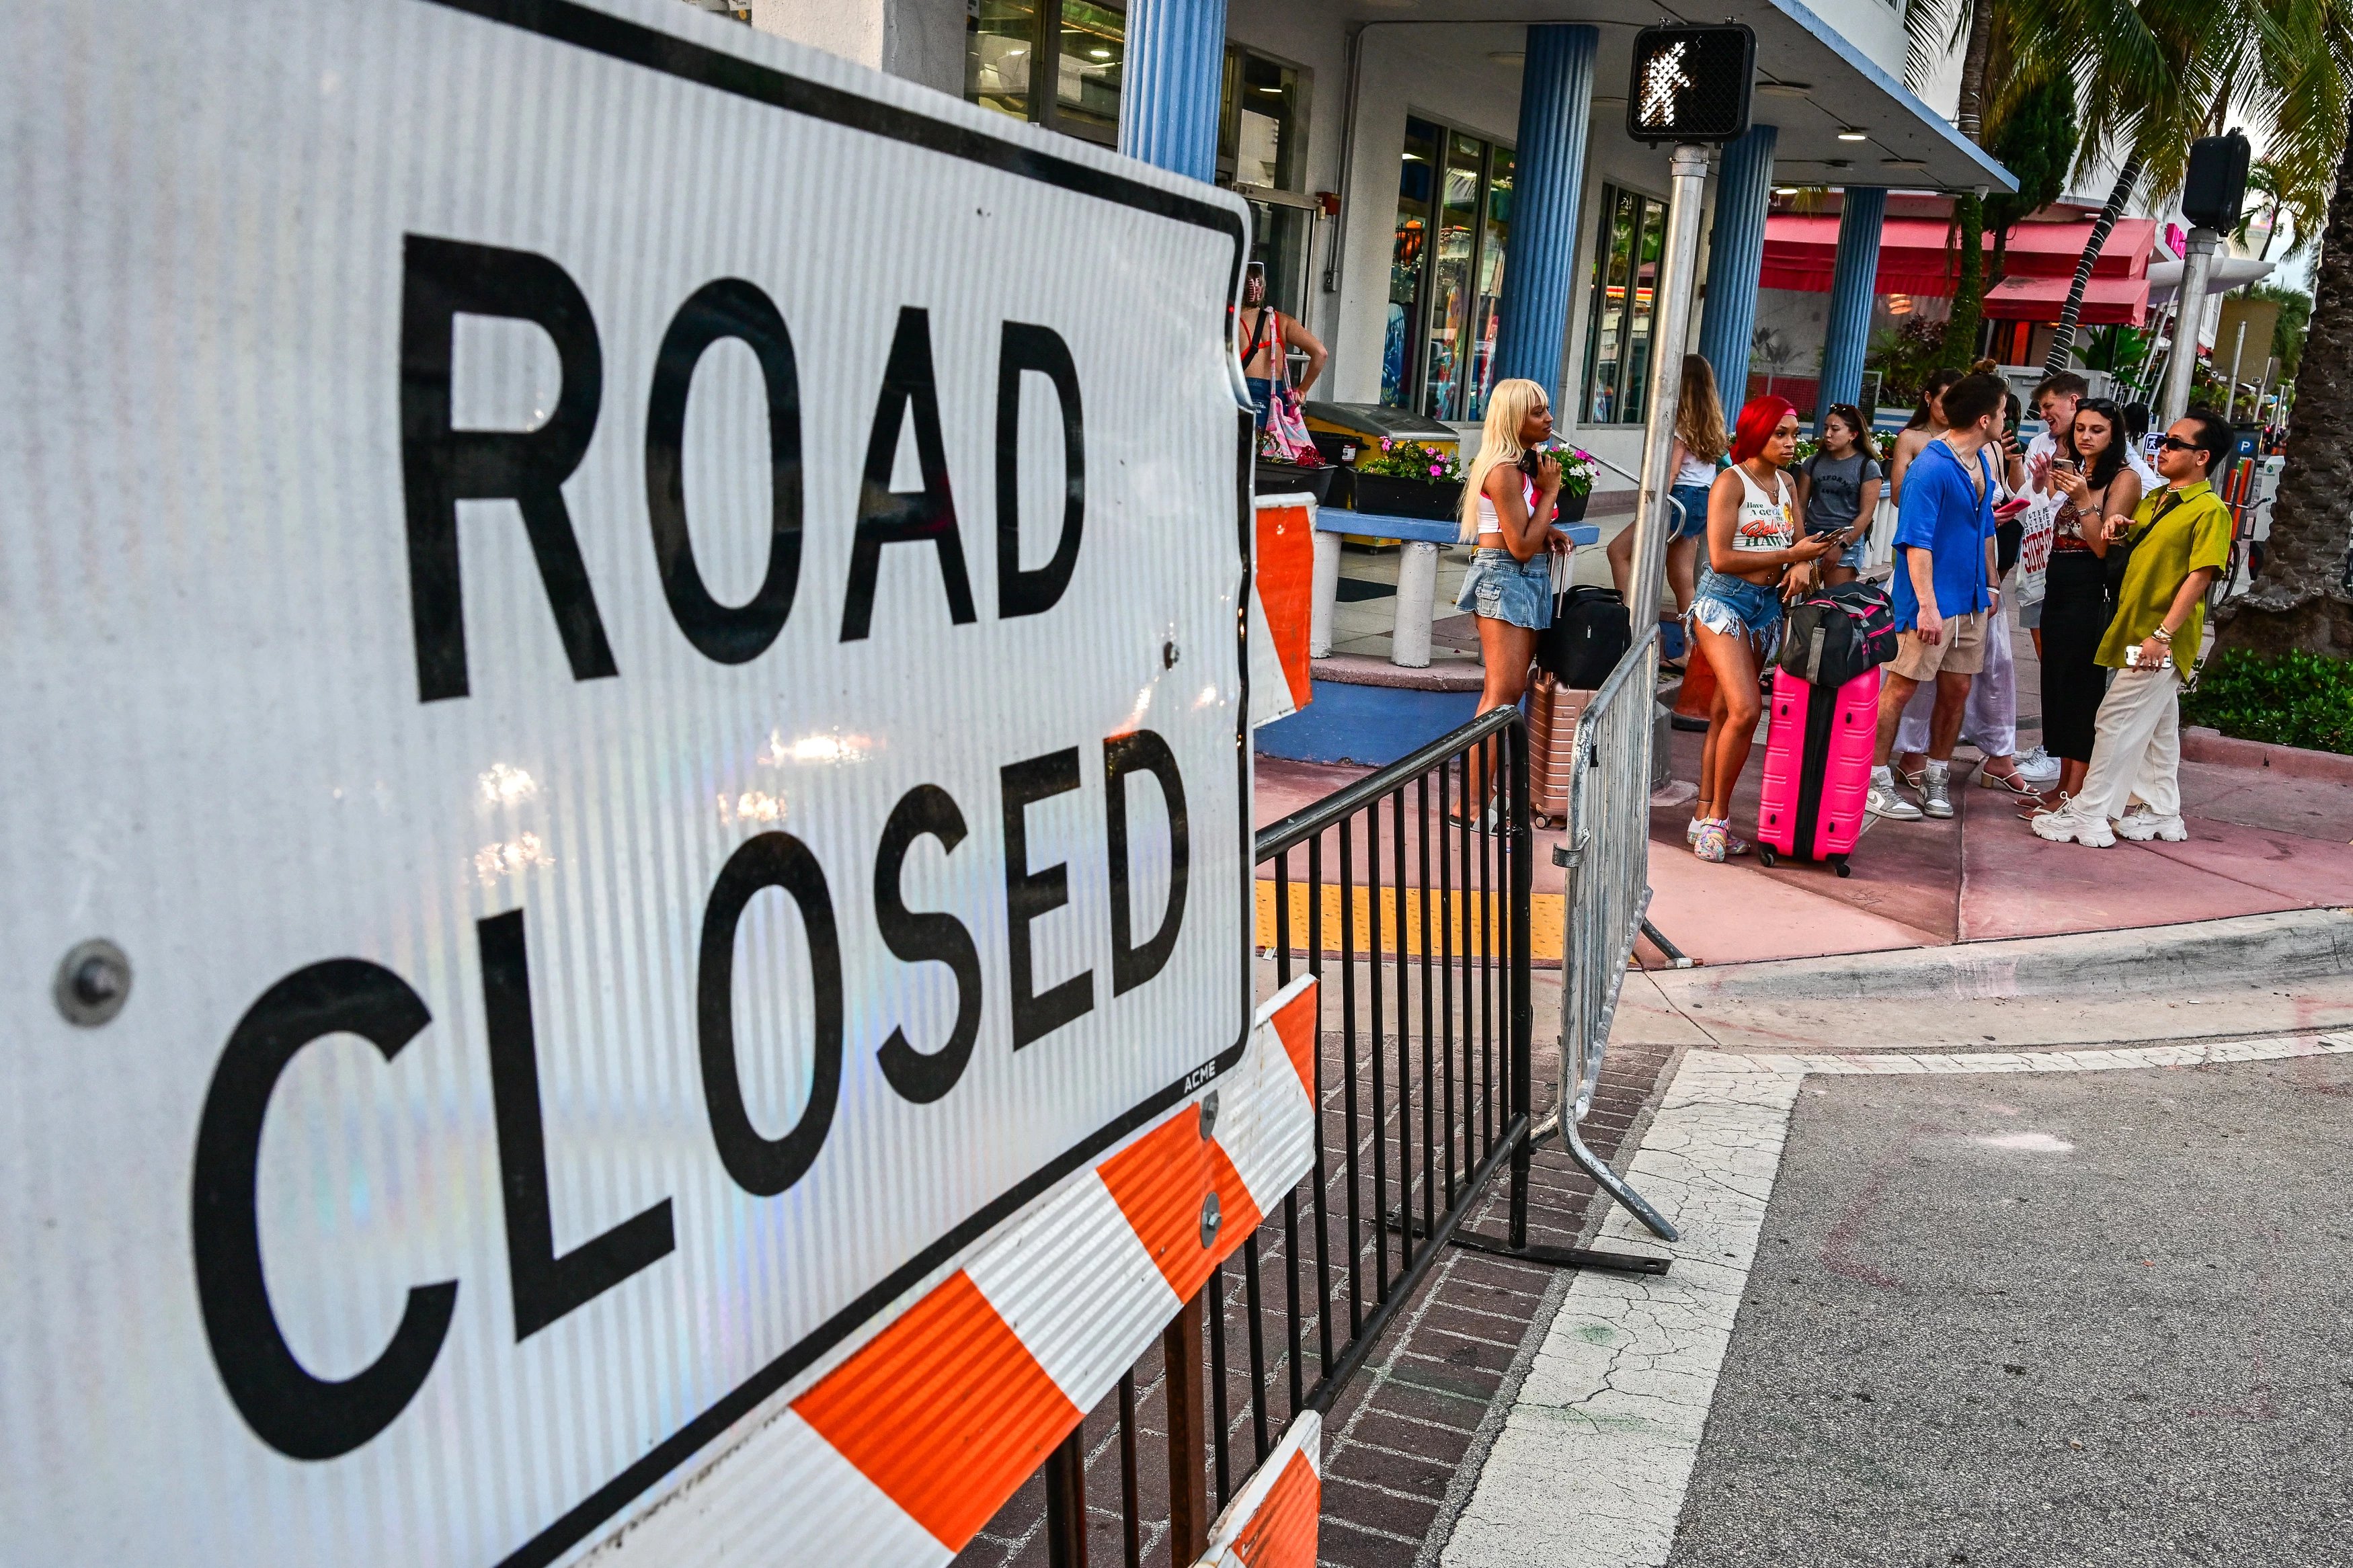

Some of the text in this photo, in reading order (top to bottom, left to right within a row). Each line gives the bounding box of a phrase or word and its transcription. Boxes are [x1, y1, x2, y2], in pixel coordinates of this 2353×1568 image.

[401, 233, 1085, 702] ROAD
[2241, 441, 2250, 451] P
[2022, 531, 2046, 574] SURF
[192, 729, 1190, 1462] CLOSED
[1184, 1060, 1215, 1094] ACME
